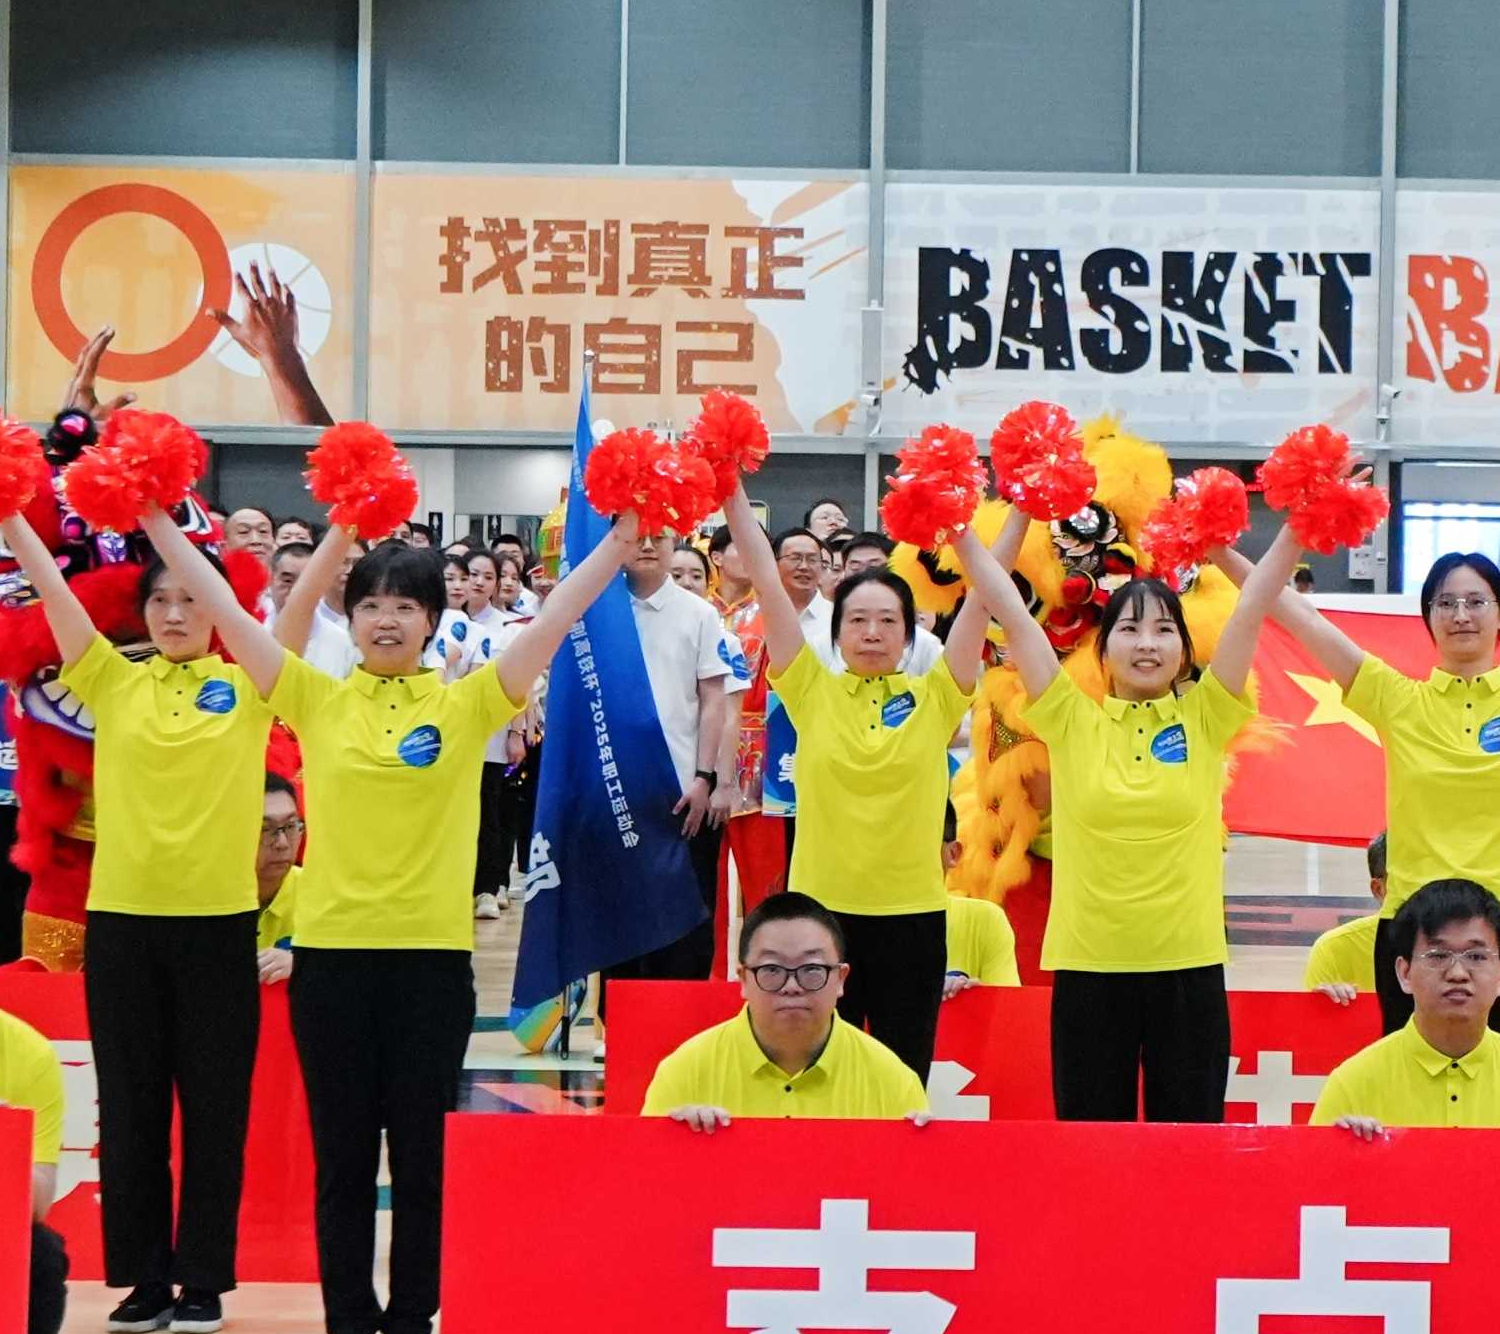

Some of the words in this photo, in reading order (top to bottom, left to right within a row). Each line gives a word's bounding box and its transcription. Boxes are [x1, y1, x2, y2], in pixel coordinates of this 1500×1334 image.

[438, 215, 806, 301] 找到真正
[484, 315, 758, 396] 的自己
[902, 246, 1371, 395] BASKET
